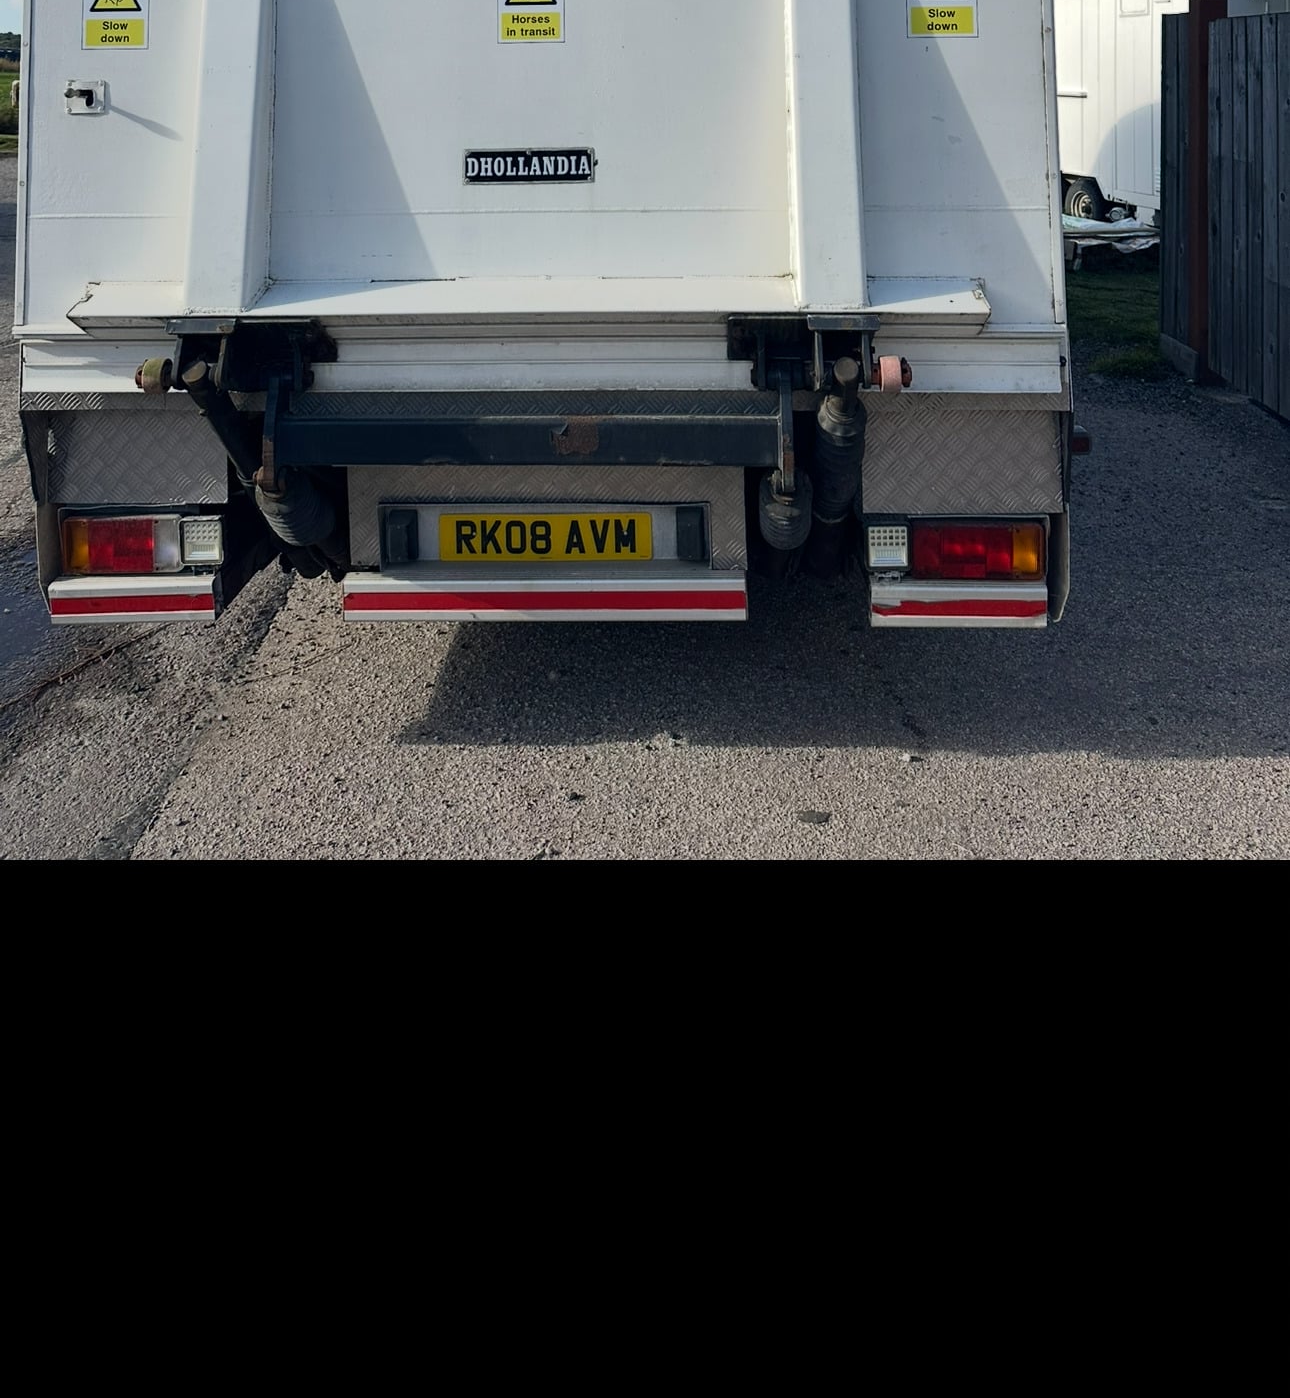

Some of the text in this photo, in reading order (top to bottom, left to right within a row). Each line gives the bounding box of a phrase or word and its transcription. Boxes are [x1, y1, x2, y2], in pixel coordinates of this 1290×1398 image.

[928, 8, 956, 18] Slow
[511, 14, 551, 24] Horses
[102, 20, 129, 31] Slow
[926, 21, 958, 31] down
[506, 26, 556, 37] in transit
[100, 33, 130, 43] down
[466, 155, 591, 178] DHOLLANDIA
[455, 518, 637, 555] RK08 AVM
